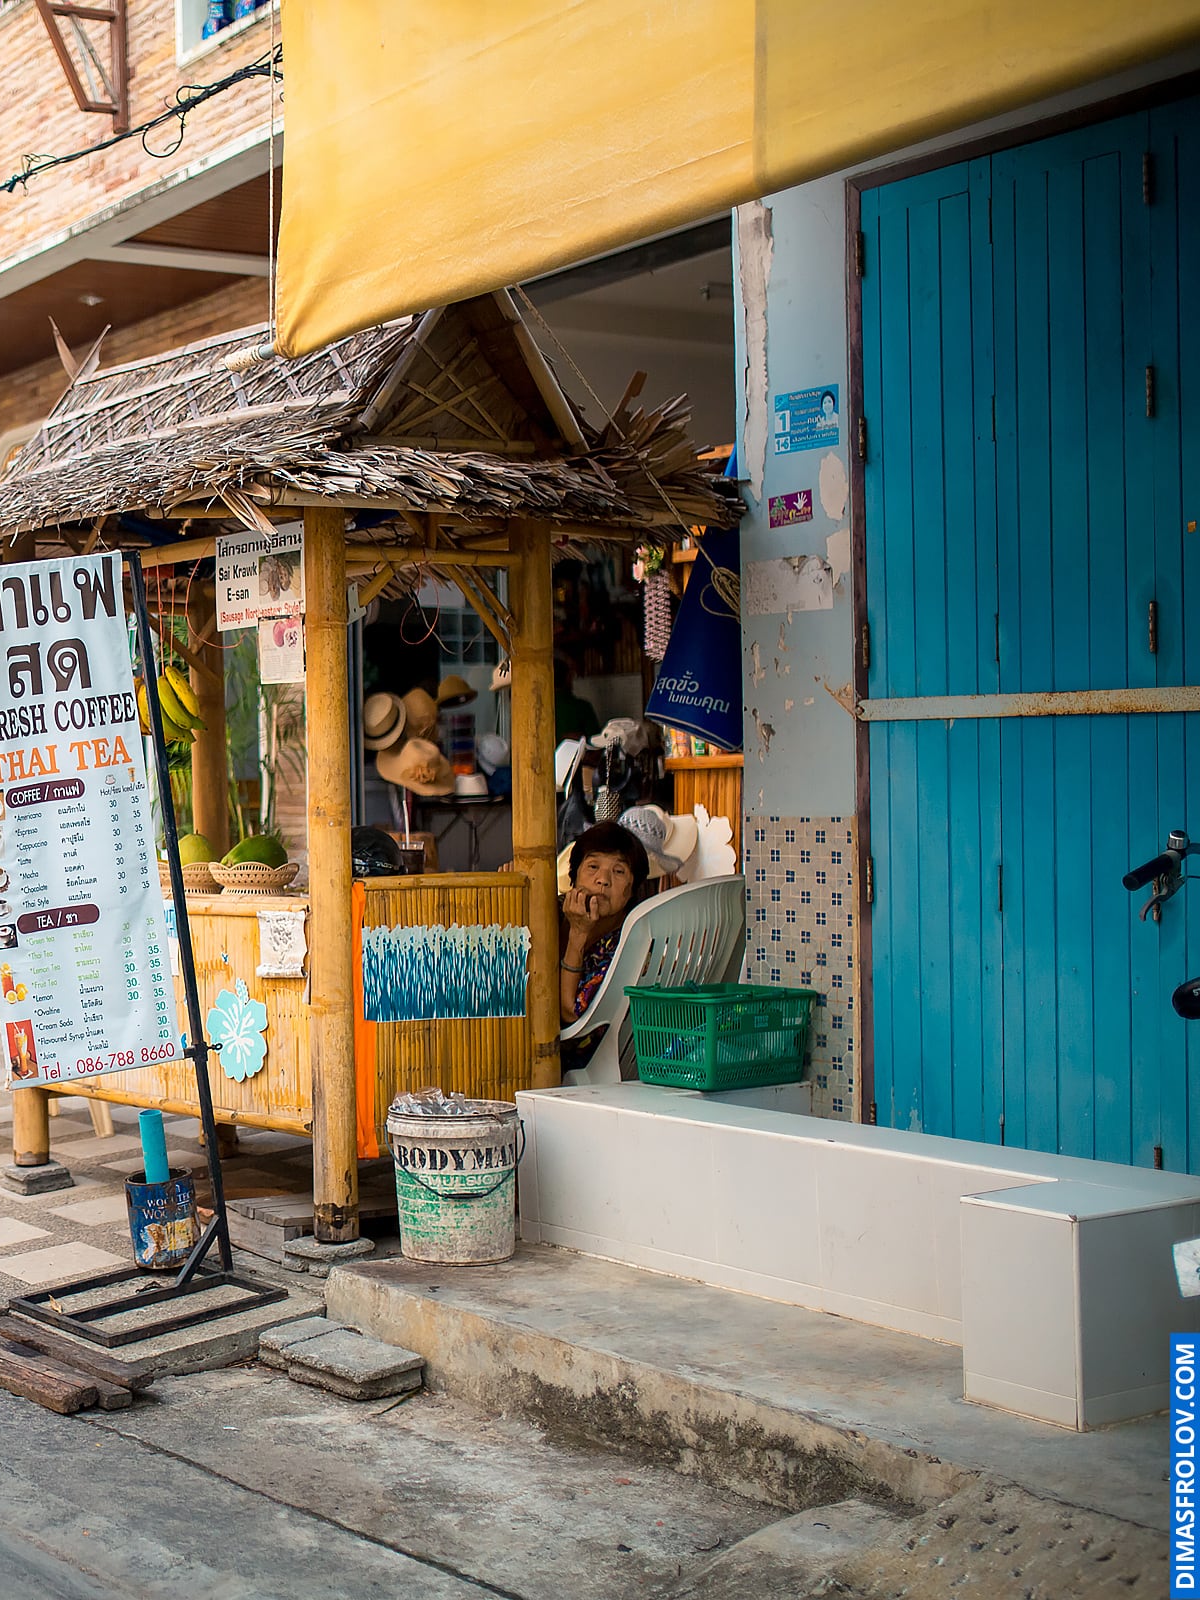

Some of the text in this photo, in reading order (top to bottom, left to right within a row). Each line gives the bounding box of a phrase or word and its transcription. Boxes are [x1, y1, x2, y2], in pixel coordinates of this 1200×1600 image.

[218, 562, 257, 581] Sai Krawk
[227, 588, 250, 602] E-san
[6, 638, 91, 698] สด
[54, 692, 135, 732] COFFEE
[70, 736, 132, 771] TEA
[11, 788, 41, 804] COFFEE
[53, 782, 80, 798] กาแฟ
[22, 870, 39, 880] Mocha
[24, 884, 48, 894] Chocolate
[24, 900, 36, 908] Thai
[37, 897, 49, 908] Style
[36, 915, 54, 928] TEA
[66, 913, 78, 923] ชา
[36, 994, 53, 1002] Lemon
[37, 1007, 60, 1017] Ovaltine
[39, 1022, 57, 1030] Cream
[59, 1018, 73, 1027] Soda
[41, 1034, 67, 1045] Flavoured
[69, 1032, 85, 1042] Syrup
[42, 1062, 60, 1080] Tel
[76, 1050, 135, 1074] 086-788
[141, 1042, 174, 1062] 8660
[43, 1052, 56, 1060] Juice
